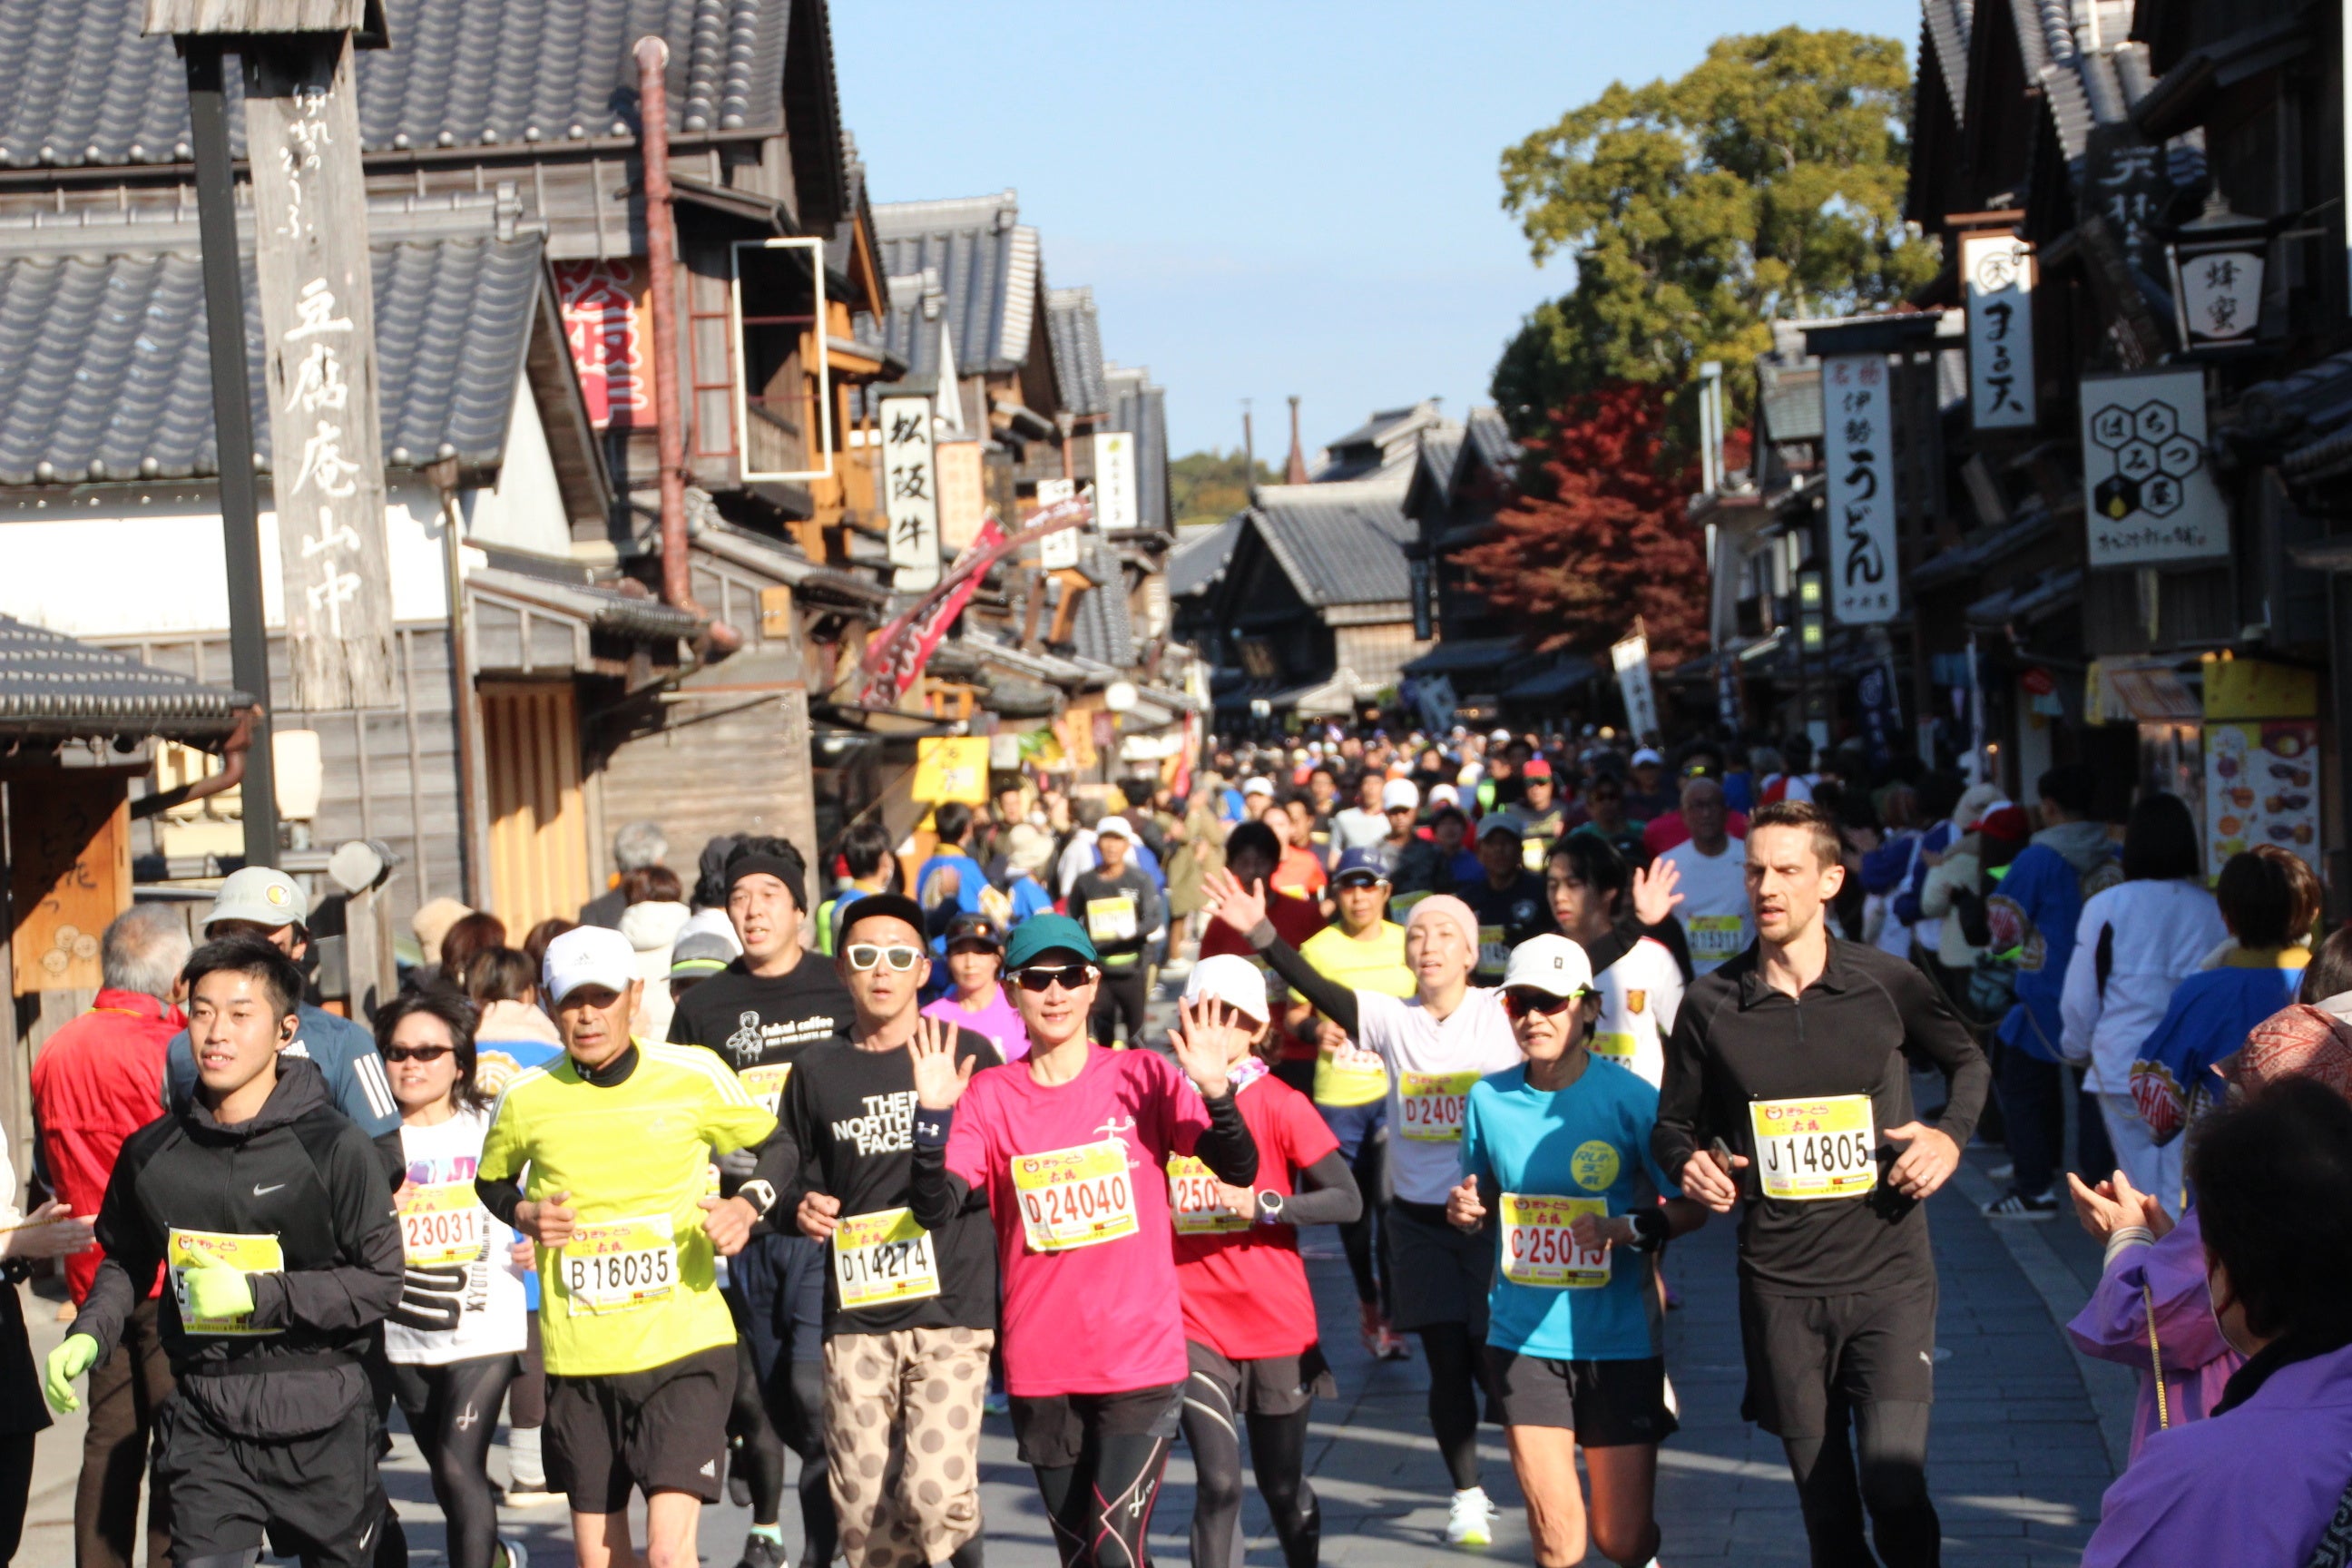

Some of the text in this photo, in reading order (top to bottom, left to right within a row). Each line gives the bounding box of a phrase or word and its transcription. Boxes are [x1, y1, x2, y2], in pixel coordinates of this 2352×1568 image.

[284, 277, 363, 637] 豆腐庵山中
[890, 409, 930, 550] 松阪牛
[798, 1015, 834, 1032] coffee
[861, 1091, 909, 1115] THE
[831, 1110, 912, 1142] NORTH
[856, 1129, 914, 1157] FACE
[1768, 1132, 1868, 1174] J14805
[1024, 1175, 1126, 1225] D24040
[572, 1250, 669, 1290] B16035
[842, 1238, 927, 1282] D14274
